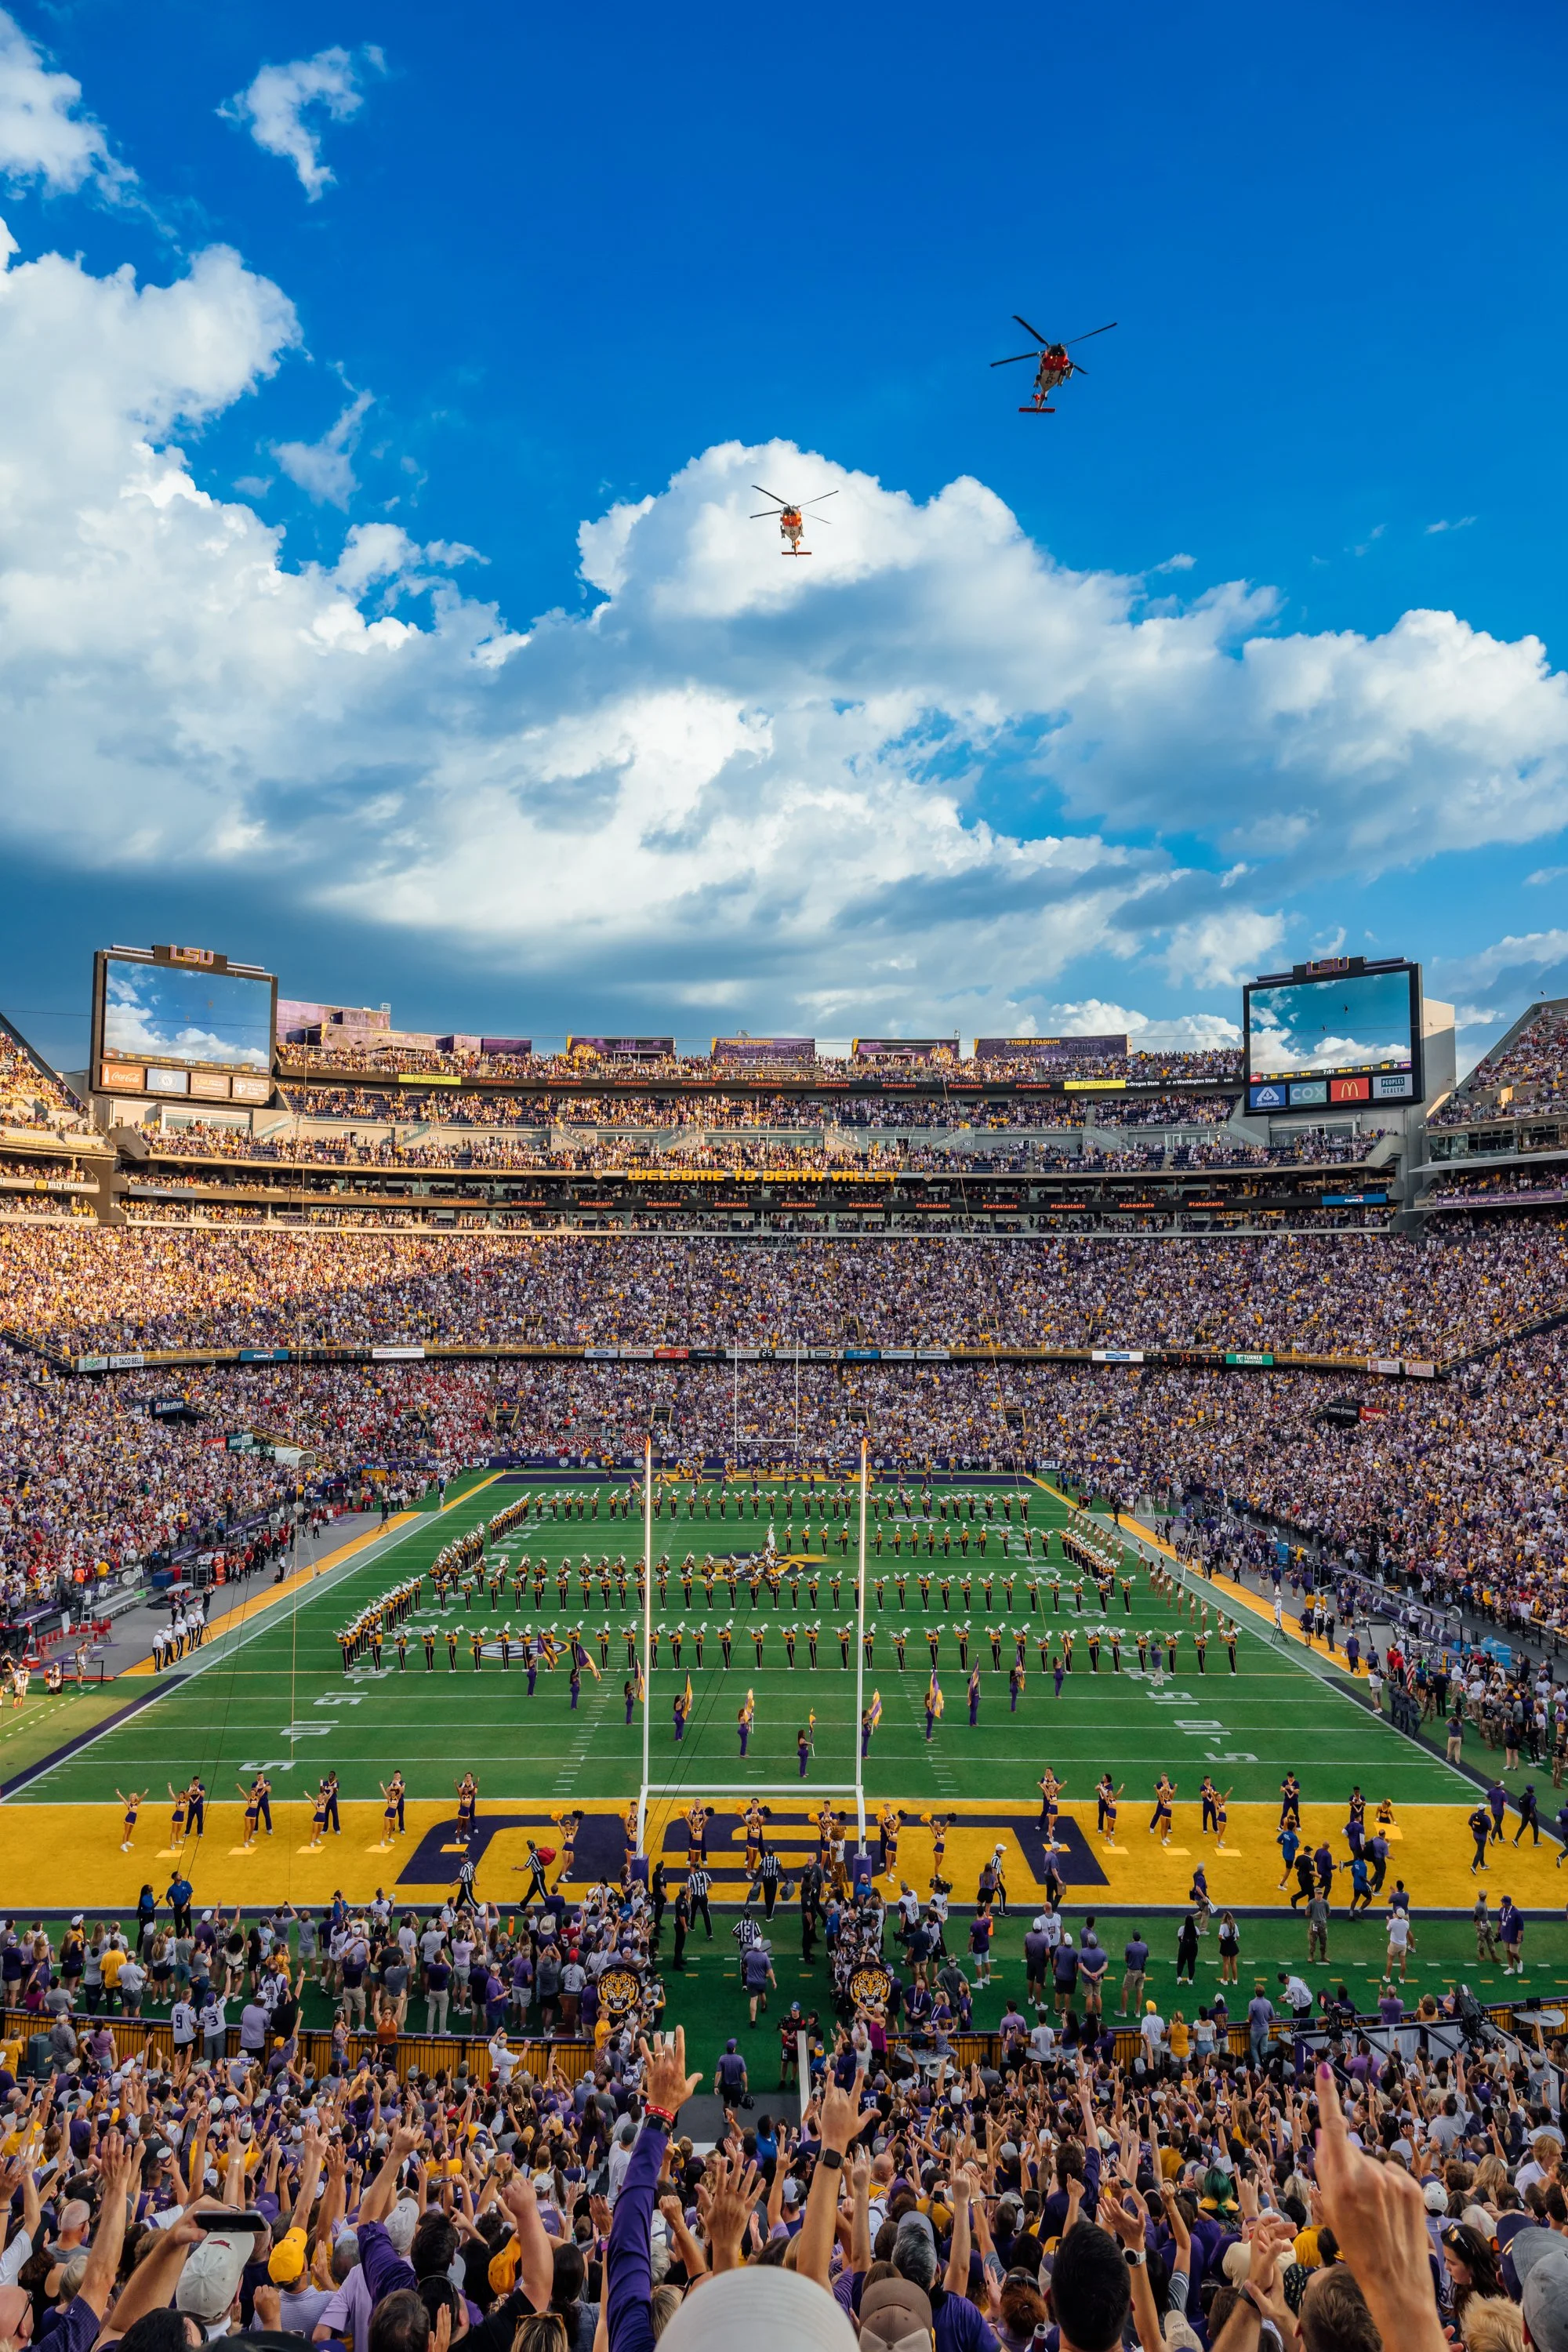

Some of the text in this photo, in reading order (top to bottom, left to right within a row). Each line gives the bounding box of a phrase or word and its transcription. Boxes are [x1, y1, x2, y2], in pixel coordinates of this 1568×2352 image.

[170, 945, 214, 965] LSU
[1306, 956, 1348, 975] LSU
[1066, 1044, 1101, 1055] CLUB
[1291, 1086, 1326, 1100] COX
[628, 1169, 898, 1182] WELCOME TO DEATH VALLEY
[762, 1348, 772, 1357] 25
[162, 1401, 183, 1411] Marathon
[313, 1691, 369, 1705] 15
[1145, 1691, 1200, 1705] 15
[279, 1720, 339, 1735] 10
[1174, 1720, 1232, 1735] 10
[1203, 1752, 1259, 1762] 5
[238, 1762, 296, 1771] 5
[561, 1933, 569, 1947] 5
[176, 2014, 183, 2029] 9
[209, 2015, 219, 2027] 3
[864, 2096, 877, 2110] 33
